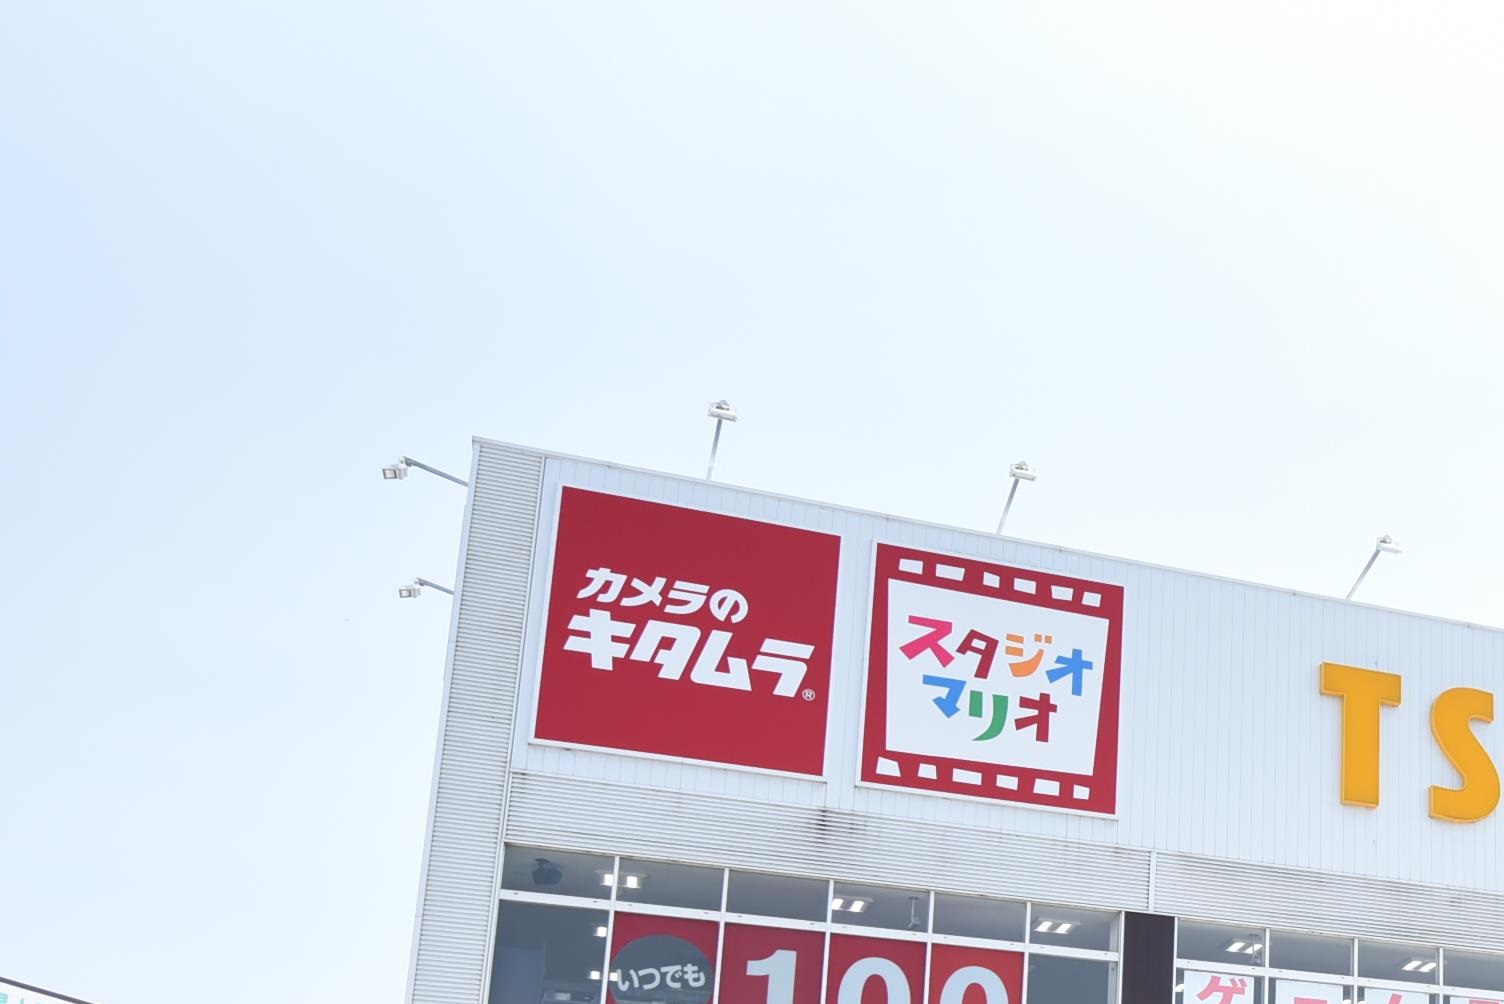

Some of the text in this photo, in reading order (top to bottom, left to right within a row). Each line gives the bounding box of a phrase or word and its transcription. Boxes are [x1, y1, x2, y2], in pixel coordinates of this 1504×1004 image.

[577, 567, 749, 625] カメラの
[562, 608, 815, 699] キタムラ
[898, 614, 1094, 697] スタジオ
[922, 673, 1058, 743] マリオ
[615, 961, 707, 993] いつでも
